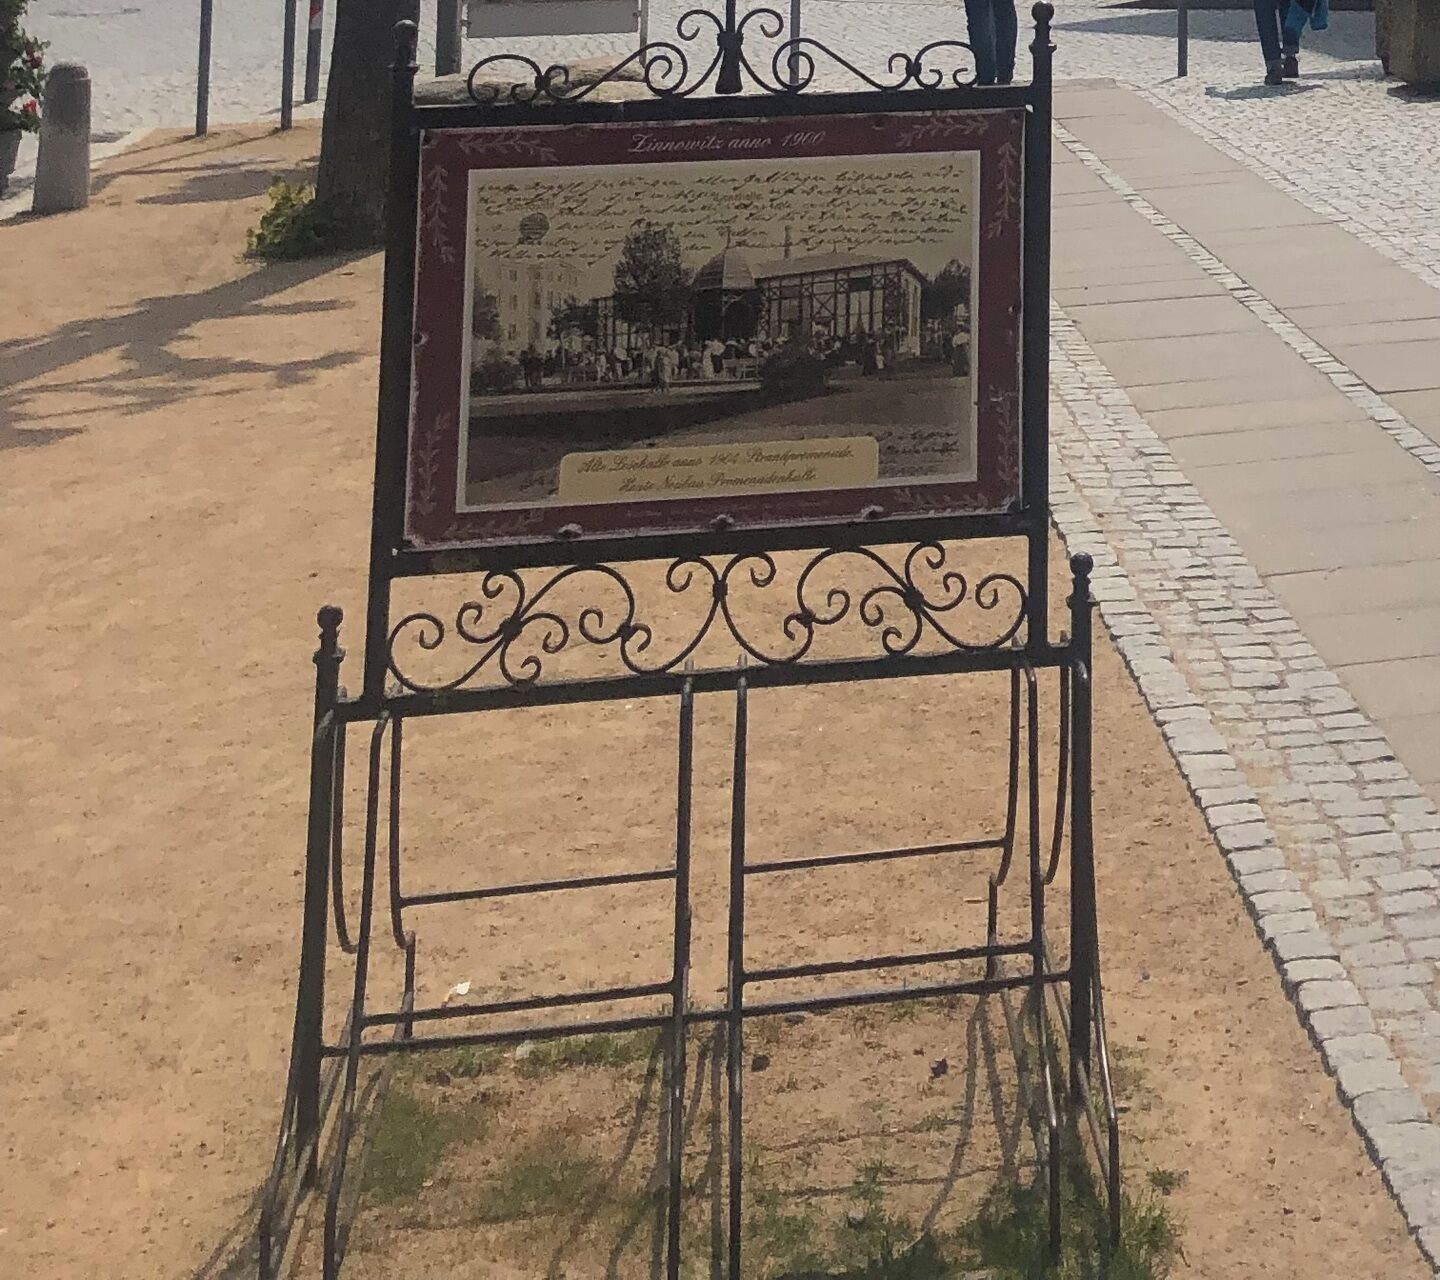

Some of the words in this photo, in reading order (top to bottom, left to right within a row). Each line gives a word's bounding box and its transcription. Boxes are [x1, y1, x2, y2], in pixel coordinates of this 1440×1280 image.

[632, 133, 725, 152] Zinnowitz
[728, 137, 772, 149] anno
[781, 130, 827, 147] 1900
